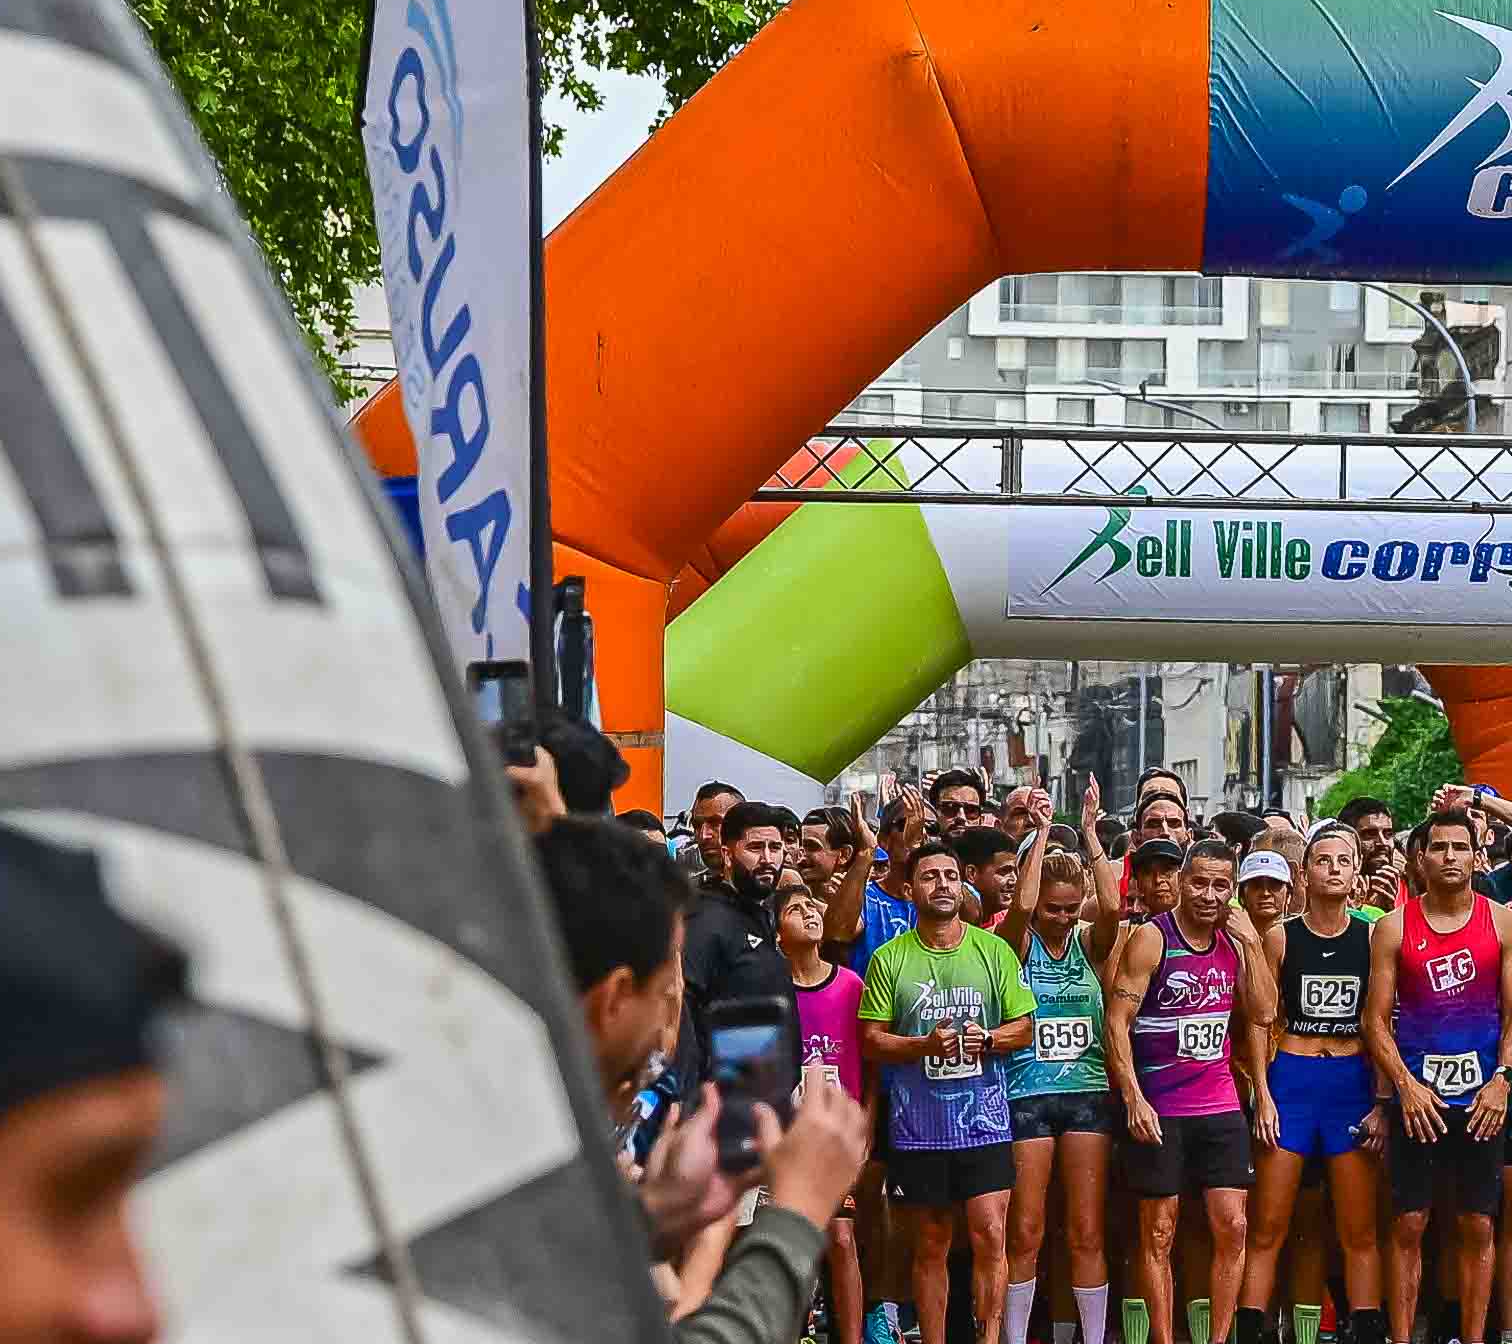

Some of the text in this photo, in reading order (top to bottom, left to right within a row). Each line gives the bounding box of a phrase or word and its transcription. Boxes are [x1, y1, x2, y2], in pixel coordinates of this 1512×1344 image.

[1213, 521, 1312, 580] Ville
[1429, 952, 1475, 990] FG
[1306, 980, 1357, 1008] 625
[1038, 1022, 1089, 1050] 659
[1183, 1022, 1225, 1050] 636
[1293, 1020, 1331, 1033] NIKE
[1427, 1057, 1477, 1086] 726
